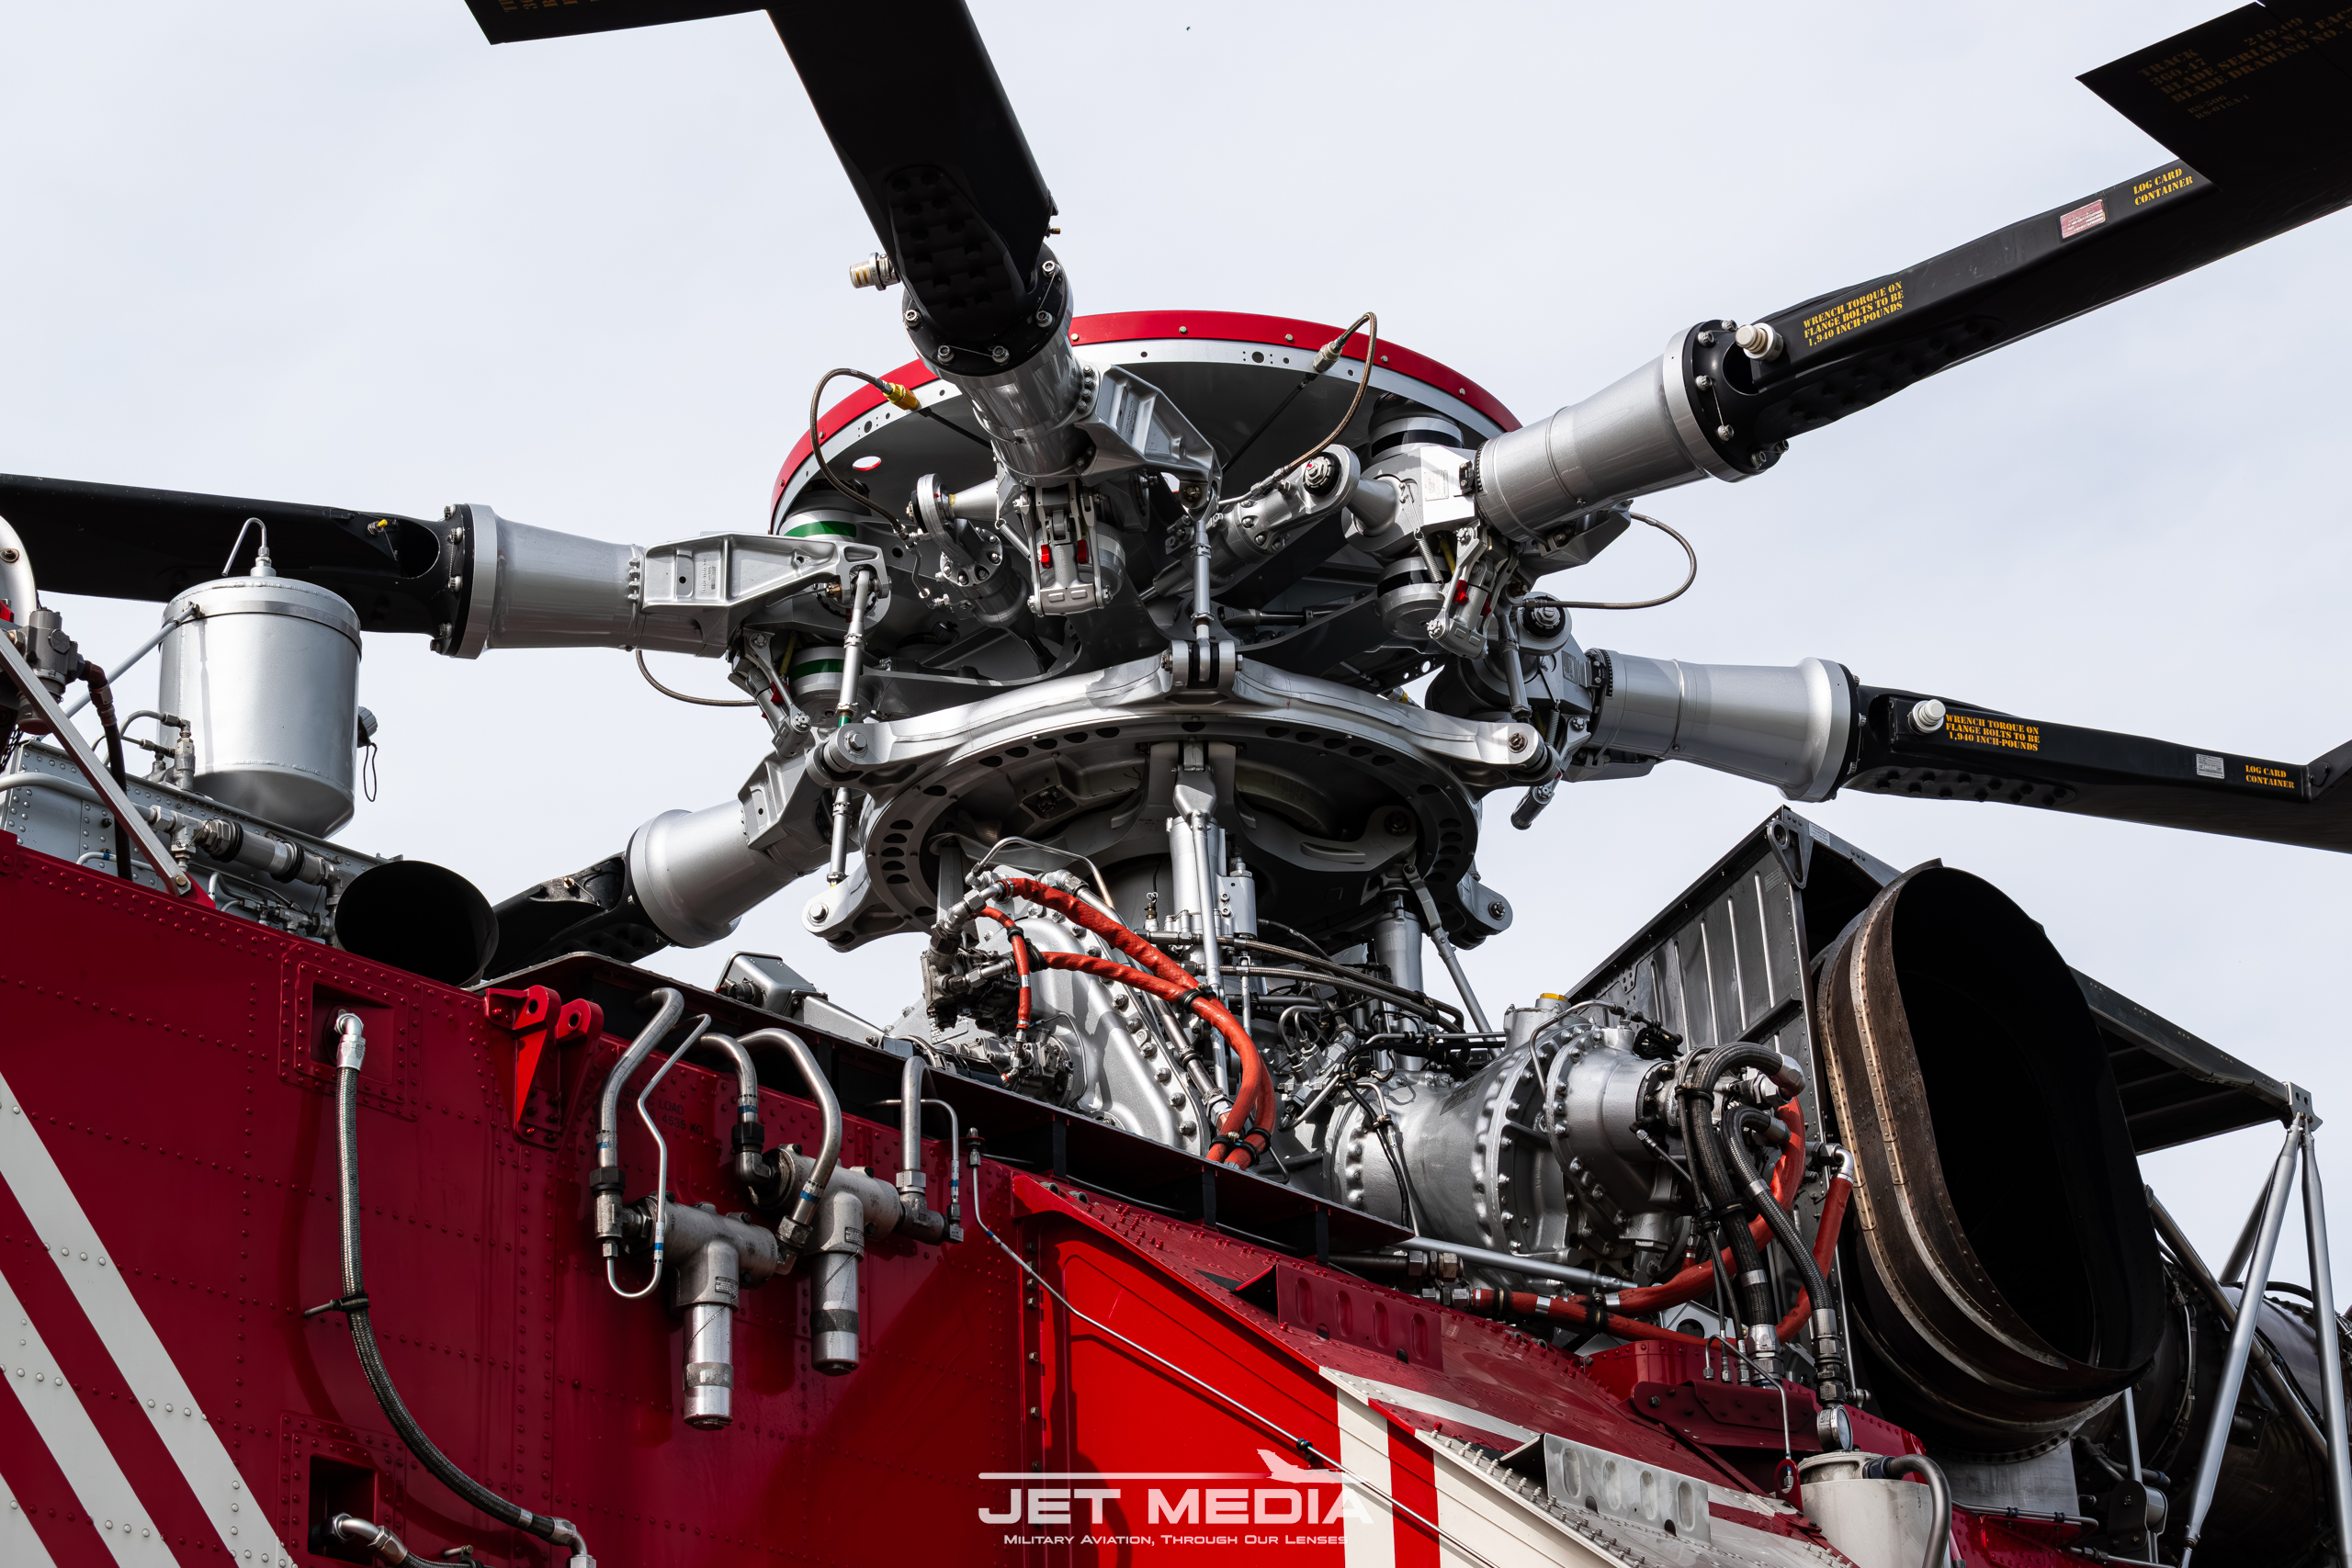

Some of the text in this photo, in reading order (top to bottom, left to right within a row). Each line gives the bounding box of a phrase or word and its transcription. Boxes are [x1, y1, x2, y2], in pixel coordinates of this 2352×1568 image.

[2137, 48, 2199, 77] TRACK
[2150, 17, 2303, 86] 360.47 219.09
[2160, 66, 2218, 95] BLADE
[2217, 40, 2282, 71] SERIAL
[2314, 7, 2352, 30] EAC
[2170, 29, 2344, 103] BLADE DRAWING NO.
[2132, 168, 2183, 195] LOG CARD
[2134, 175, 2194, 206] CONTAINER
[1803, 280, 1903, 329] WRENCH TORQUE ON
[1804, 289, 1905, 339] FLANGE BOLTS TO BE
[1808, 300, 1903, 347] 1,940 INCH-POUNDS
[1945, 714, 2040, 736] WRENCH TORQUE ON
[1945, 722, 2041, 744] FLANGE BOLTS TO BE
[1949, 731, 2039, 751] 1,940 INCH-POUNDS
[2245, 764, 2287, 778] LOG CARD
[2245, 774, 2295, 789] CONTAINER
[659, 1098, 684, 1115] LOAD
[662, 1114, 686, 1131] 4535
[690, 1122, 704, 1136] KG
